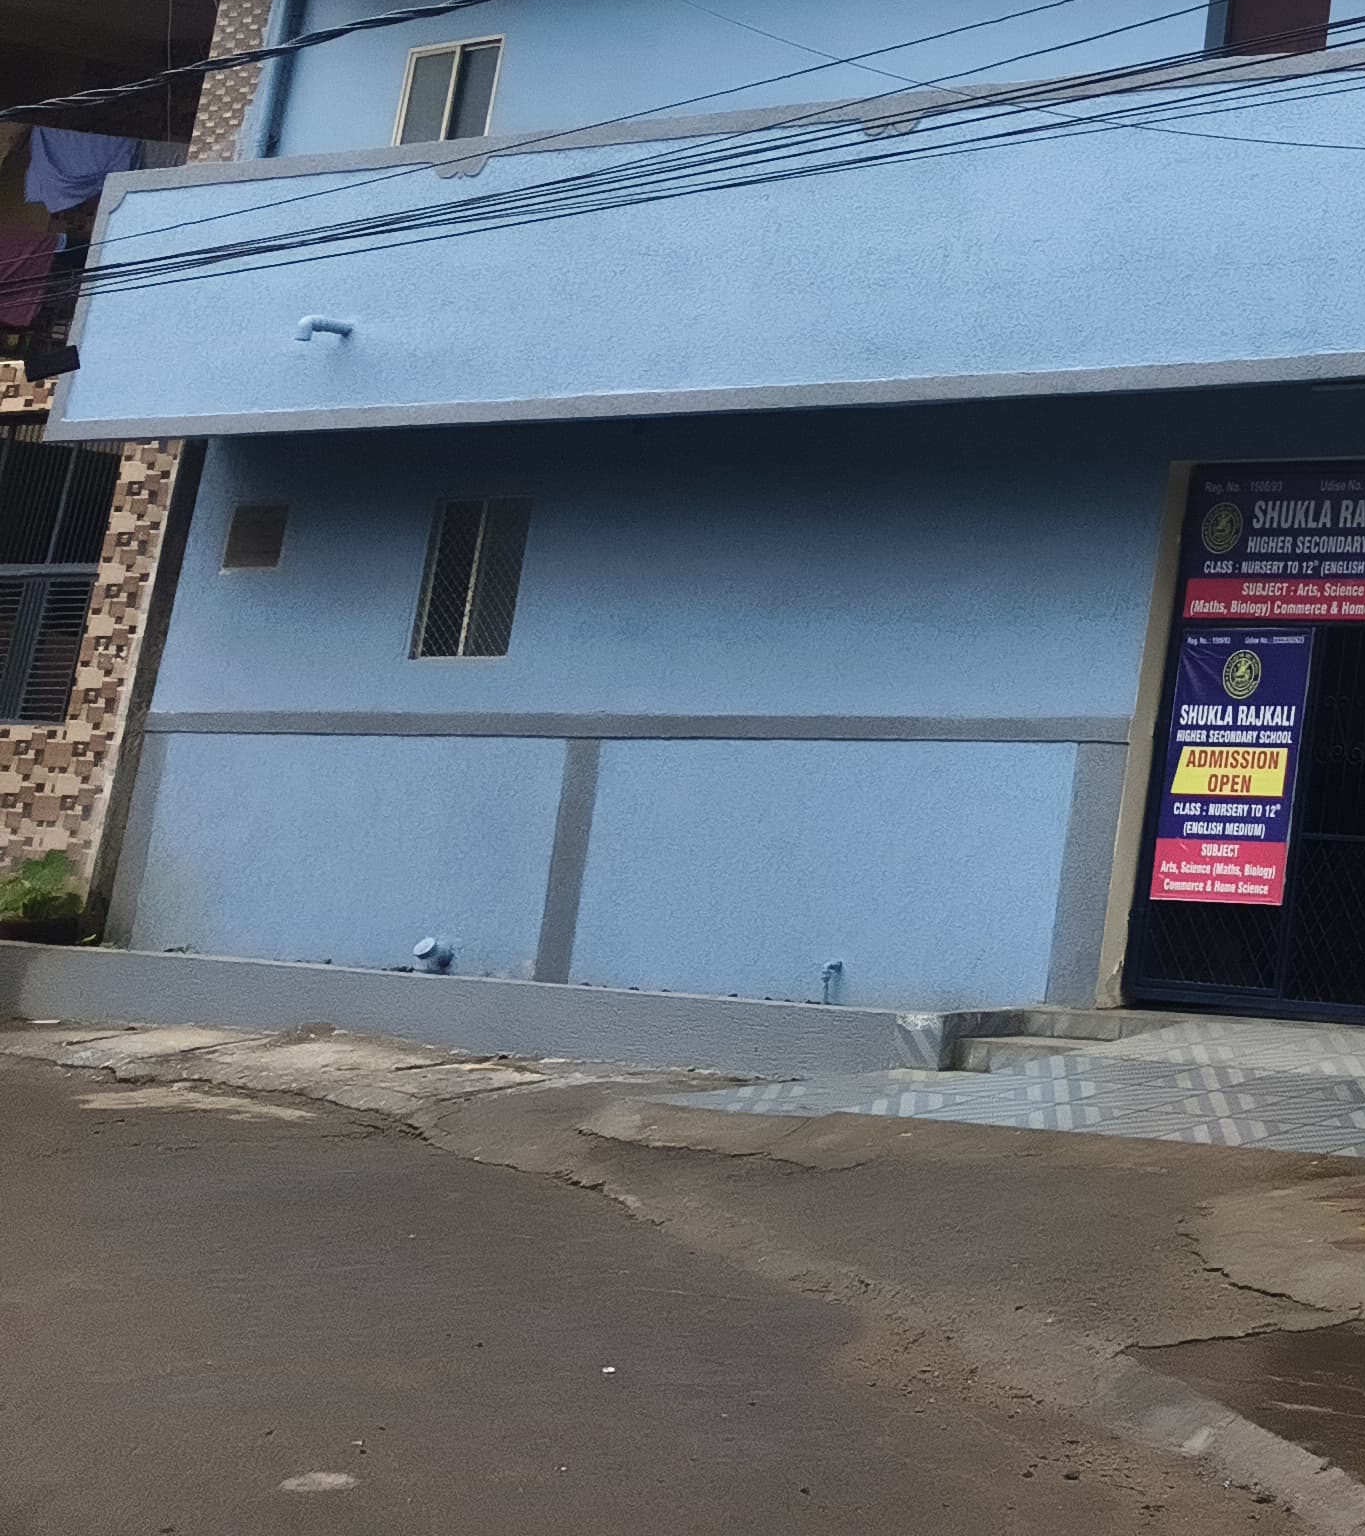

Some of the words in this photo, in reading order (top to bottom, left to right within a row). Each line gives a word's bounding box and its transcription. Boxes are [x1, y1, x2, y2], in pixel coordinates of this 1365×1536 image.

[1252, 499, 1331, 529] SHUKLA
[1246, 536, 1293, 553] HIGHER
[1204, 561, 1233, 574] CLASS
[1241, 561, 1283, 574] NURSERY
[1286, 561, 1298, 574] TO
[1321, 561, 1365, 576] (ENGLISH
[1242, 583, 1288, 596] SUBJECT
[1297, 584, 1321, 598] Arts,
[1324, 583, 1364, 596] Science
[1190, 600, 1228, 615] (Maths,
[1230, 601, 1271, 616] Biology)
[1274, 601, 1327, 615] Commerce
[1330, 601, 1339, 614] &
[1180, 704, 1233, 725] SHUKLA
[1237, 705, 1296, 726] RAJKALI
[1176, 729, 1207, 743] HIGHER
[1208, 730, 1258, 743] SECONDARY
[1259, 731, 1293, 744] SCHOOL
[1185, 749, 1280, 770] ADMISSION
[1207, 774, 1252, 793] OPEN
[1173, 802, 1201, 815] CLASS
[1208, 803, 1249, 817] NURSERY
[1251, 804, 1263, 817] TO
[1183, 821, 1223, 836] (ENGLISH
[1225, 822, 1266, 839] MEDIUM)
[1201, 843, 1240, 857] SUBJECT
[1160, 861, 1179, 875] Arts,
[1180, 861, 1211, 875] Science
[1213, 862, 1242, 877] (Maths,
[1244, 864, 1276, 879] Biology)
[1163, 878, 1204, 892] Commerce
[1205, 880, 1212, 892] &
[1214, 880, 1236, 893] Home
[1238, 881, 1269, 895] Science
